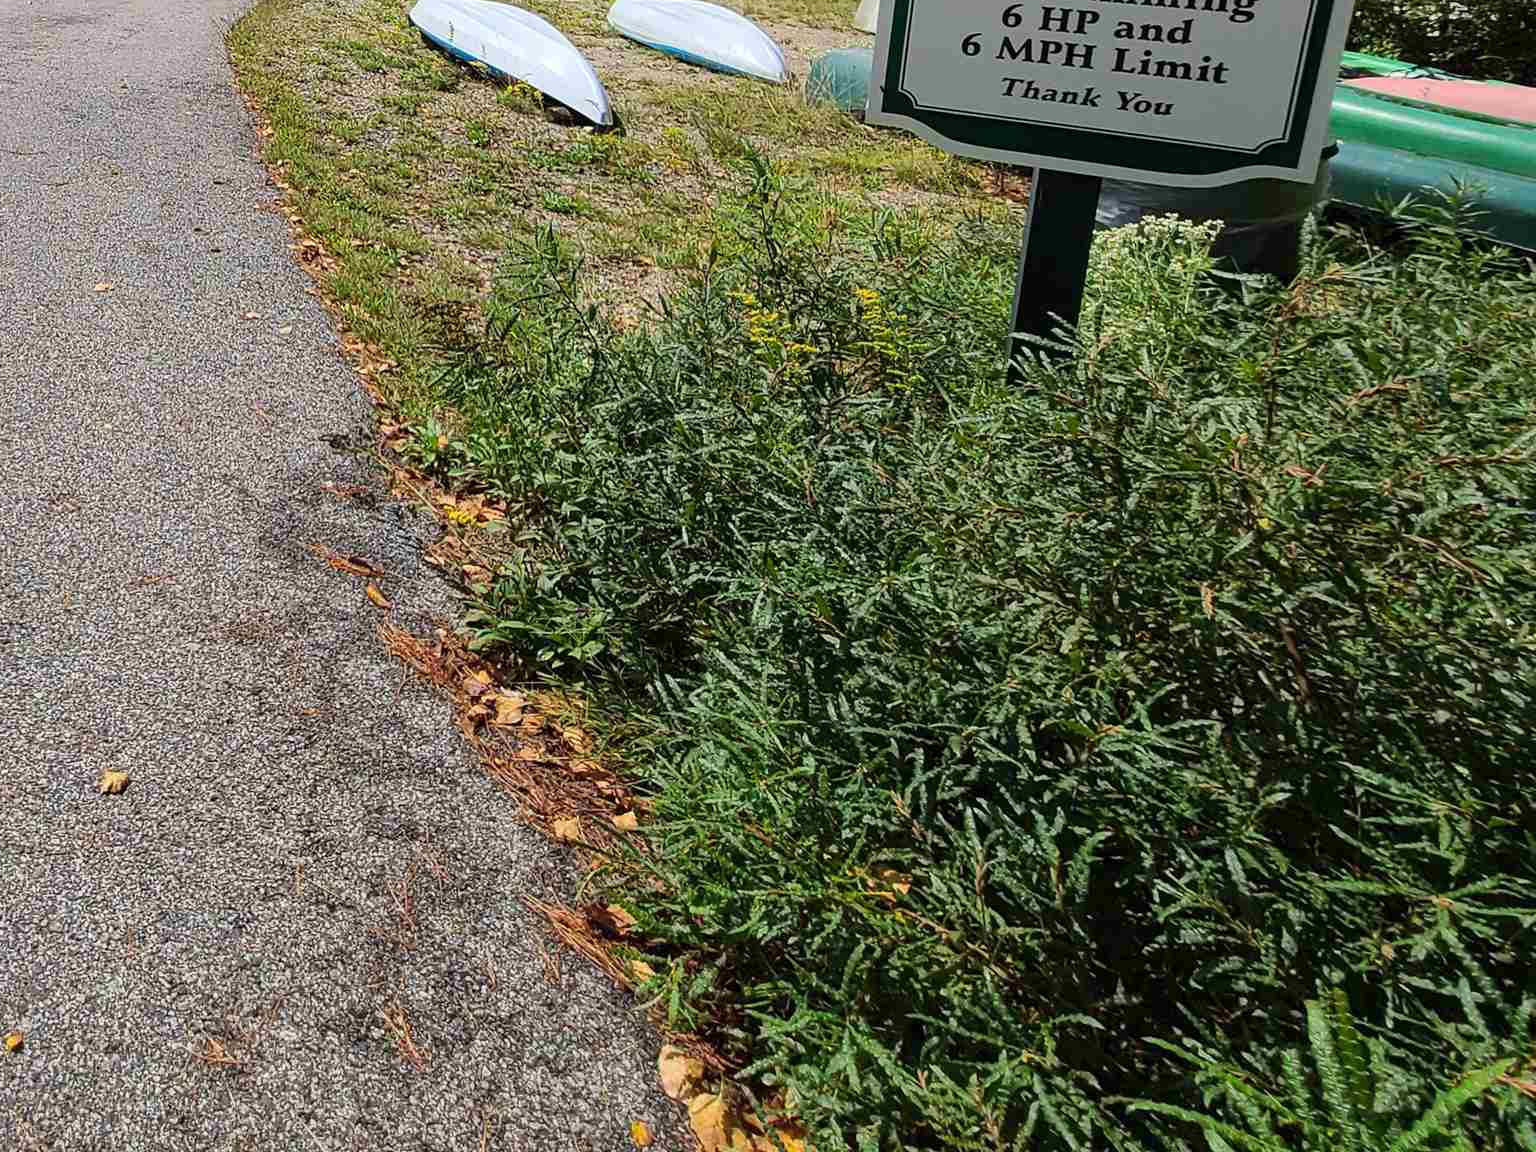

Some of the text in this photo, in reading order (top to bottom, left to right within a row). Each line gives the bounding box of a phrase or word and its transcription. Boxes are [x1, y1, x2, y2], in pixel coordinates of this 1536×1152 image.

[1001, 3, 1194, 45] 6 HP and
[961, 32, 1230, 84] 6 MPH Limit
[1001, 77, 1175, 116] Thank You
